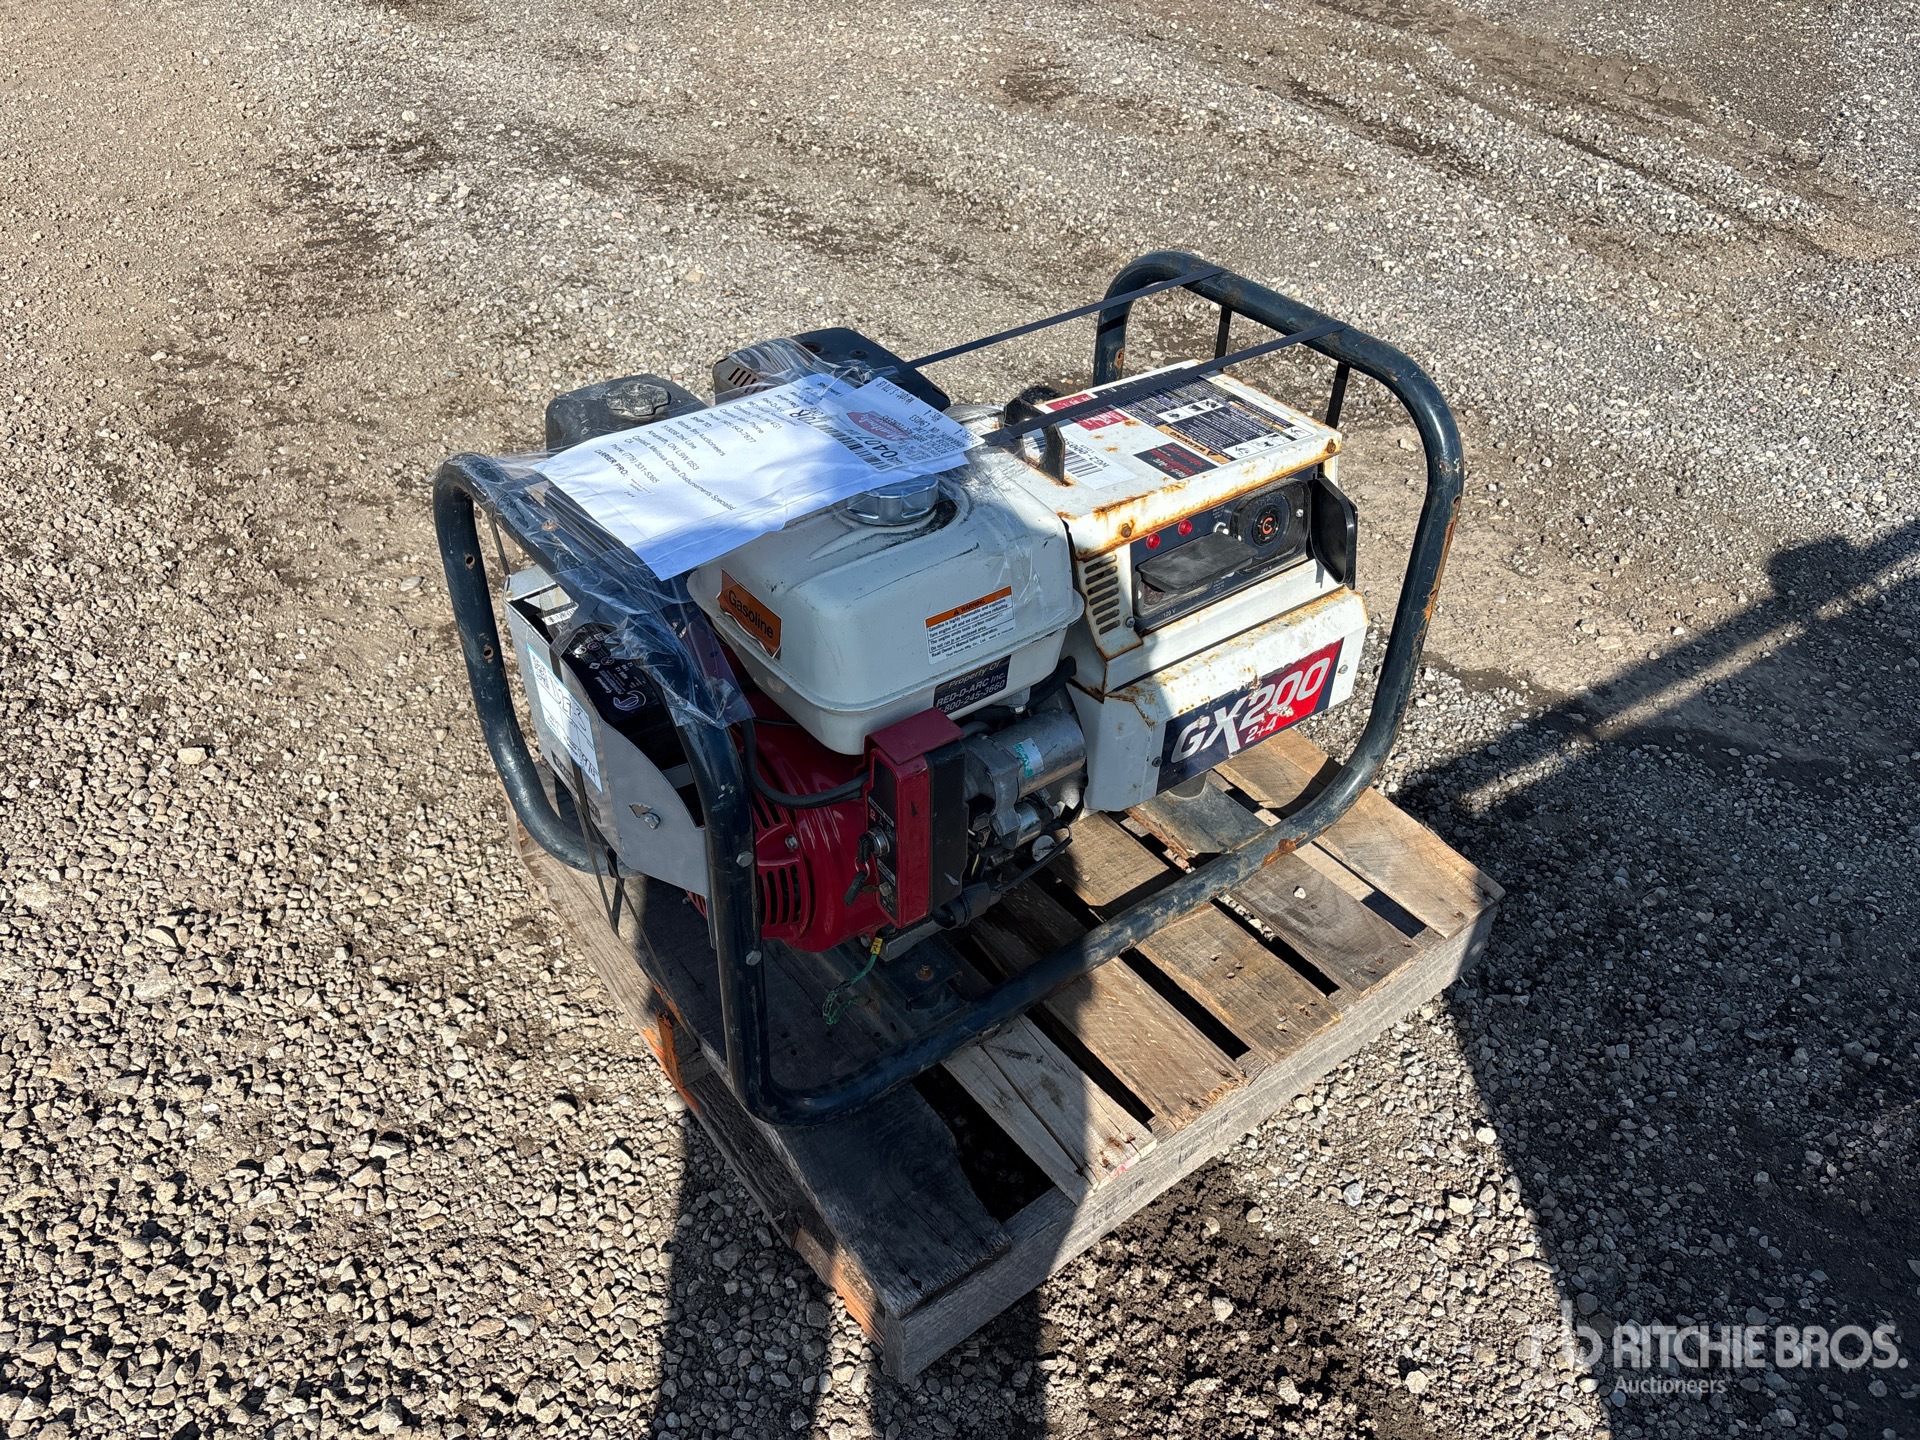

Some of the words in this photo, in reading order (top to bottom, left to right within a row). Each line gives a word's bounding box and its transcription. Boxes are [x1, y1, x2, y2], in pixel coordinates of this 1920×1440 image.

[700, 434, 726, 456] Auctioneers
[1170, 432, 1206, 452] WARNING
[594, 450, 617, 464] CARRIER
[648, 445, 668, 461] Melissa
[666, 460, 680, 474] Chan
[678, 472, 712, 497] Disbursements
[711, 494, 736, 510] Specialist
[728, 590, 774, 639] Gasoline
[961, 598, 986, 612] WARNING
[948, 668, 988, 688] Property
[936, 678, 990, 707] RED-D-ARC
[1171, 657, 1331, 763] GX200
[1245, 716, 1277, 745] 2+4
